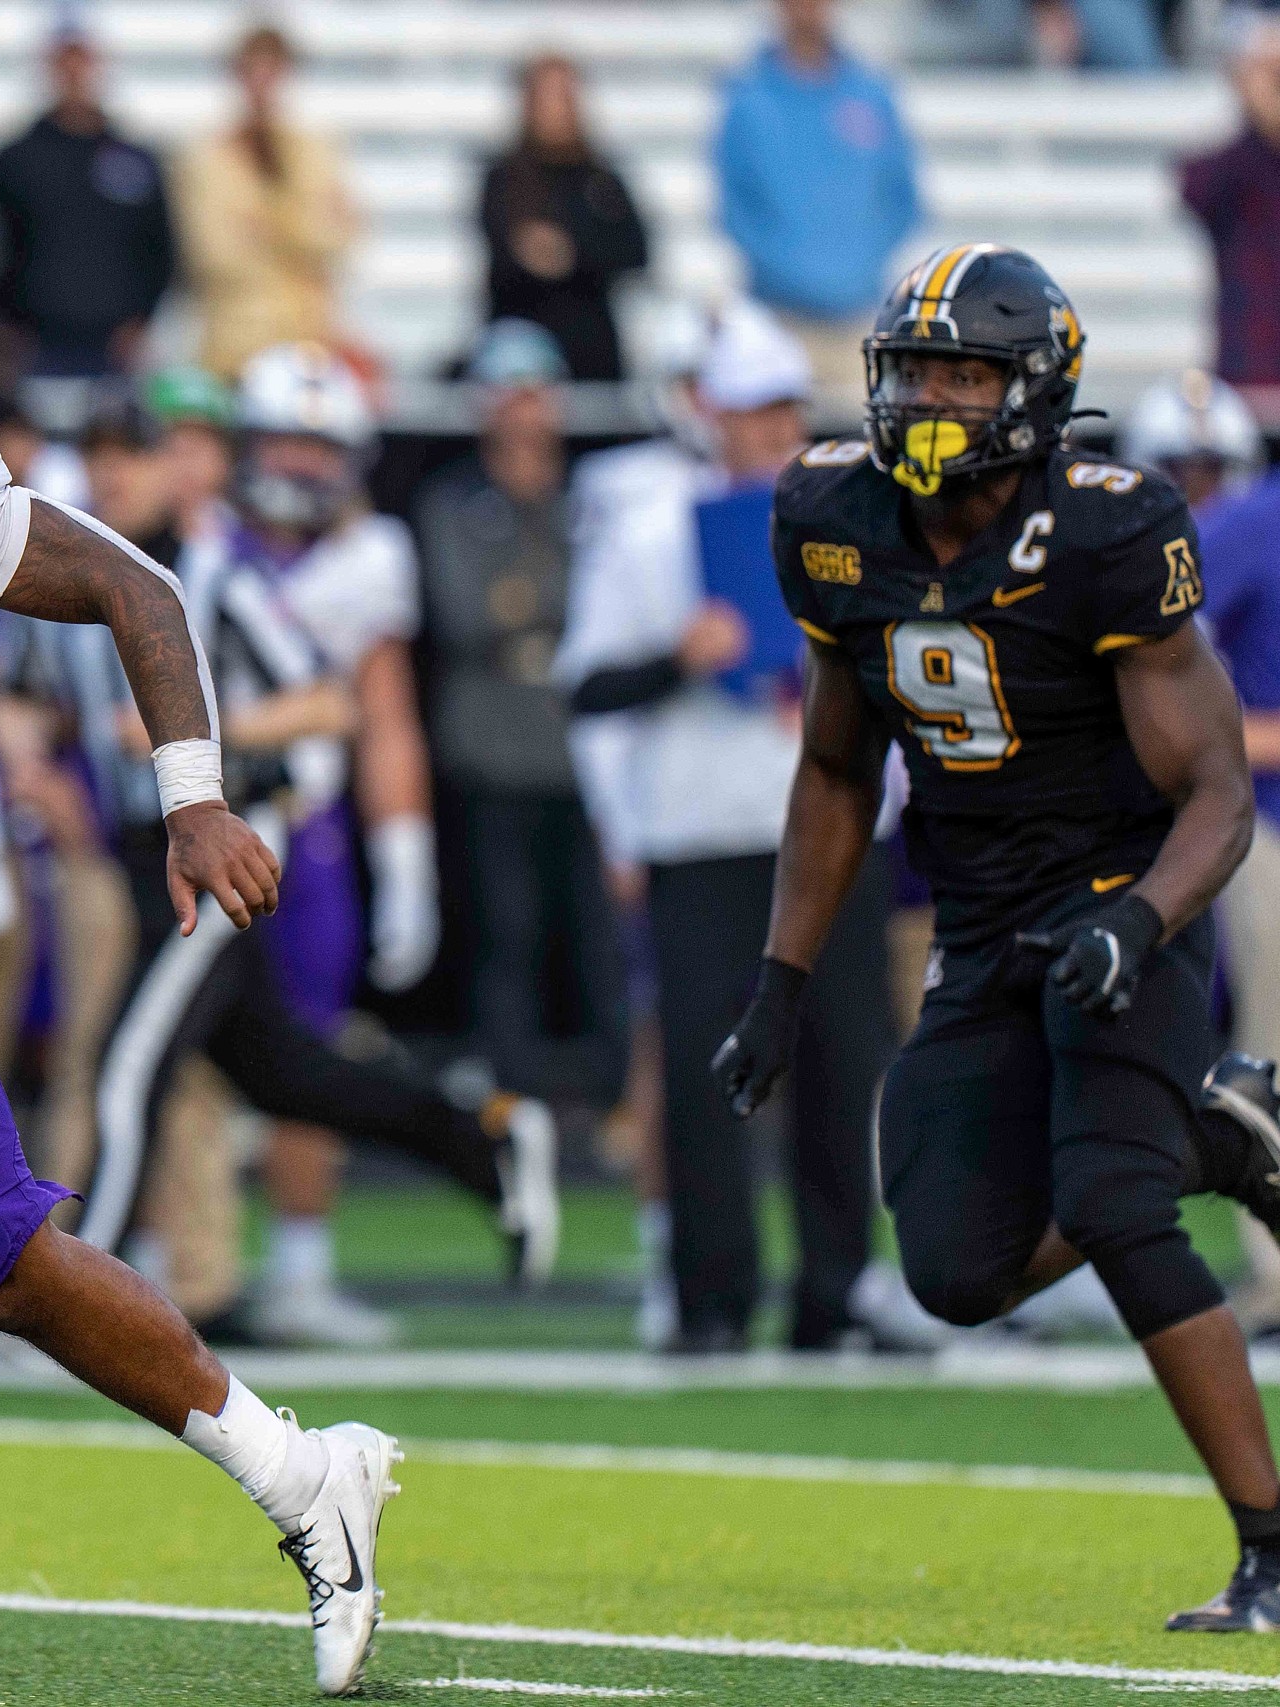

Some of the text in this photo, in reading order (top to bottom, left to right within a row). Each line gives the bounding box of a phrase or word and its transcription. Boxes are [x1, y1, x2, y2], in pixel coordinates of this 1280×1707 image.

[1065, 461, 1144, 495] 9
[801, 541, 862, 585] SBC
[1008, 510, 1056, 575] C
[1160, 537, 1204, 617] A
[883, 617, 1023, 772] 9
